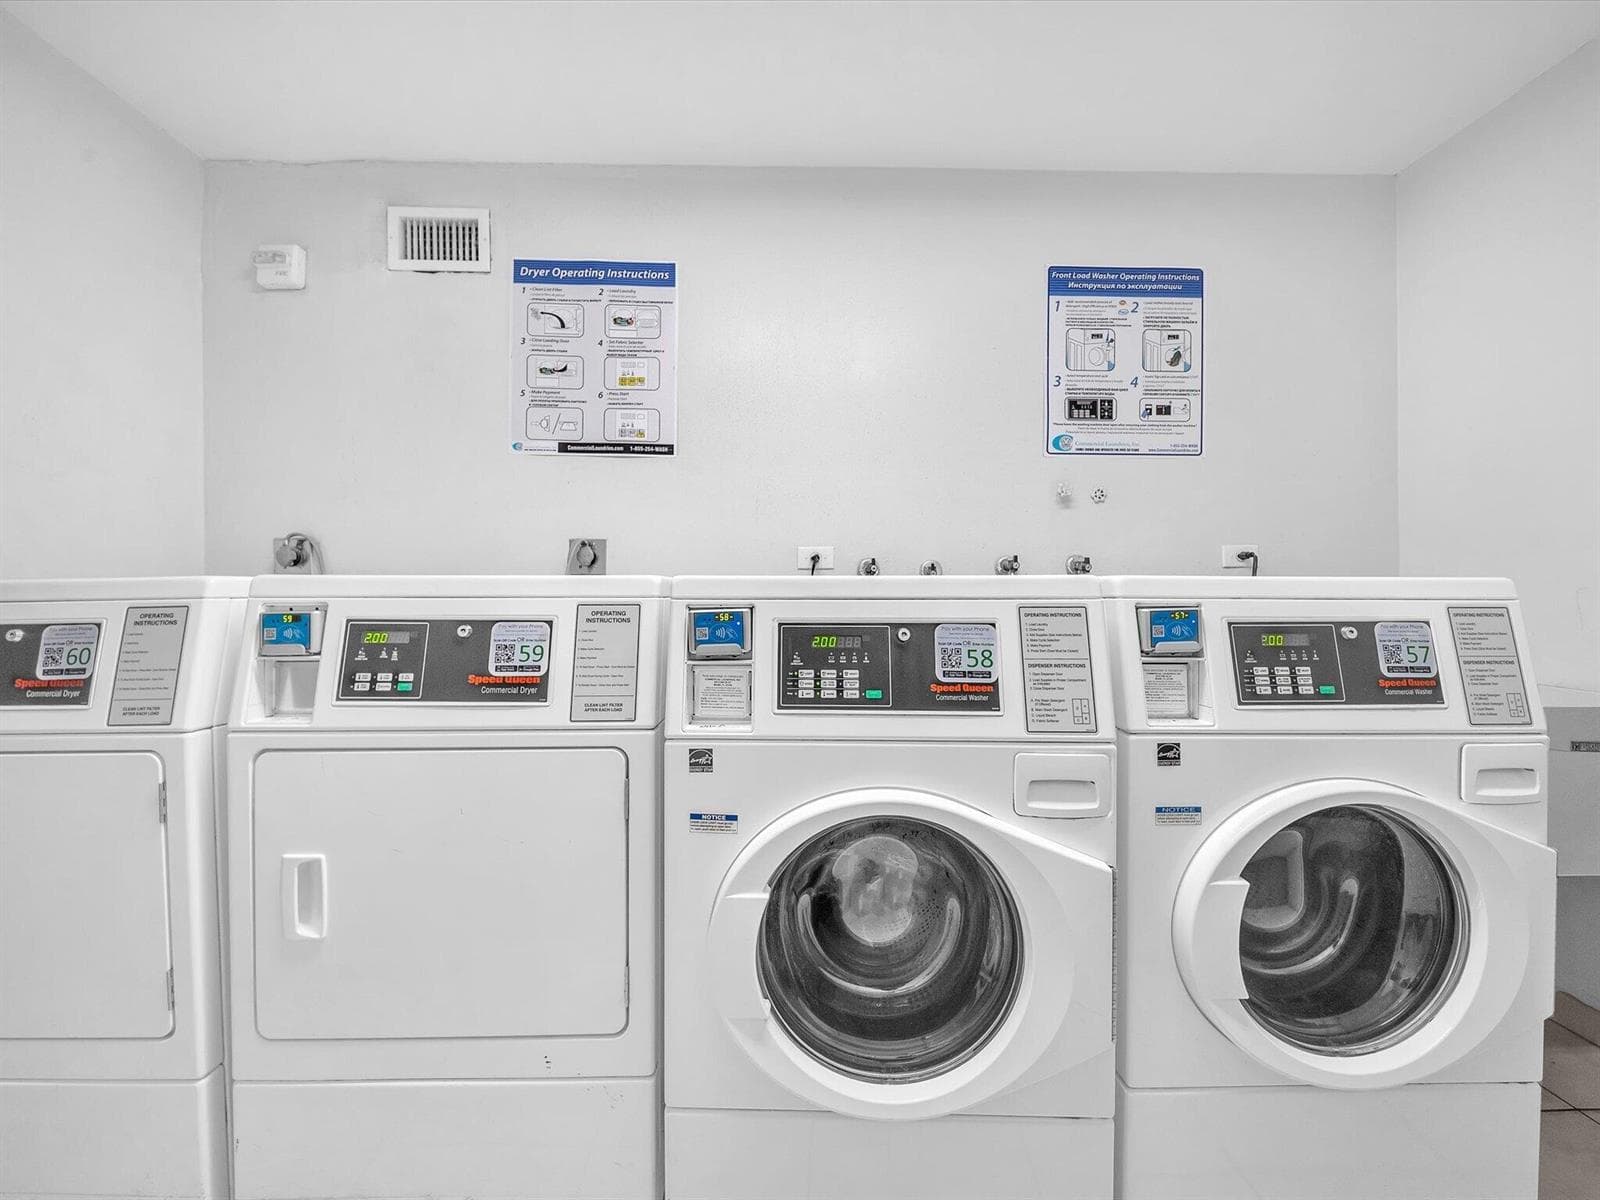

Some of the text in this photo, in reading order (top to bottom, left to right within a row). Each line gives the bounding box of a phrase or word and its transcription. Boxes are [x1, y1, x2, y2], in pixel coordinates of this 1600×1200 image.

[520, 266, 670, 279] Dryer Operating Instructions
[1120, 273, 1156, 281] Operating
[1056, 301, 1060, 312] 1
[1131, 302, 1139, 313] 2
[1054, 376, 1061, 387] 3
[1130, 377, 1138, 387] 4
[812, 636, 837, 648] 2.00
[66, 648, 91, 665] 60
[519, 645, 544, 662] 59
[967, 649, 994, 668] 58
[1407, 646, 1429, 663] 57
[468, 674, 503, 685] Speed
[1379, 679, 1407, 687] Speed
[520, 686, 538, 695] Dryer
[930, 684, 961, 692] Speed
[63, 690, 80, 698] Dryer
